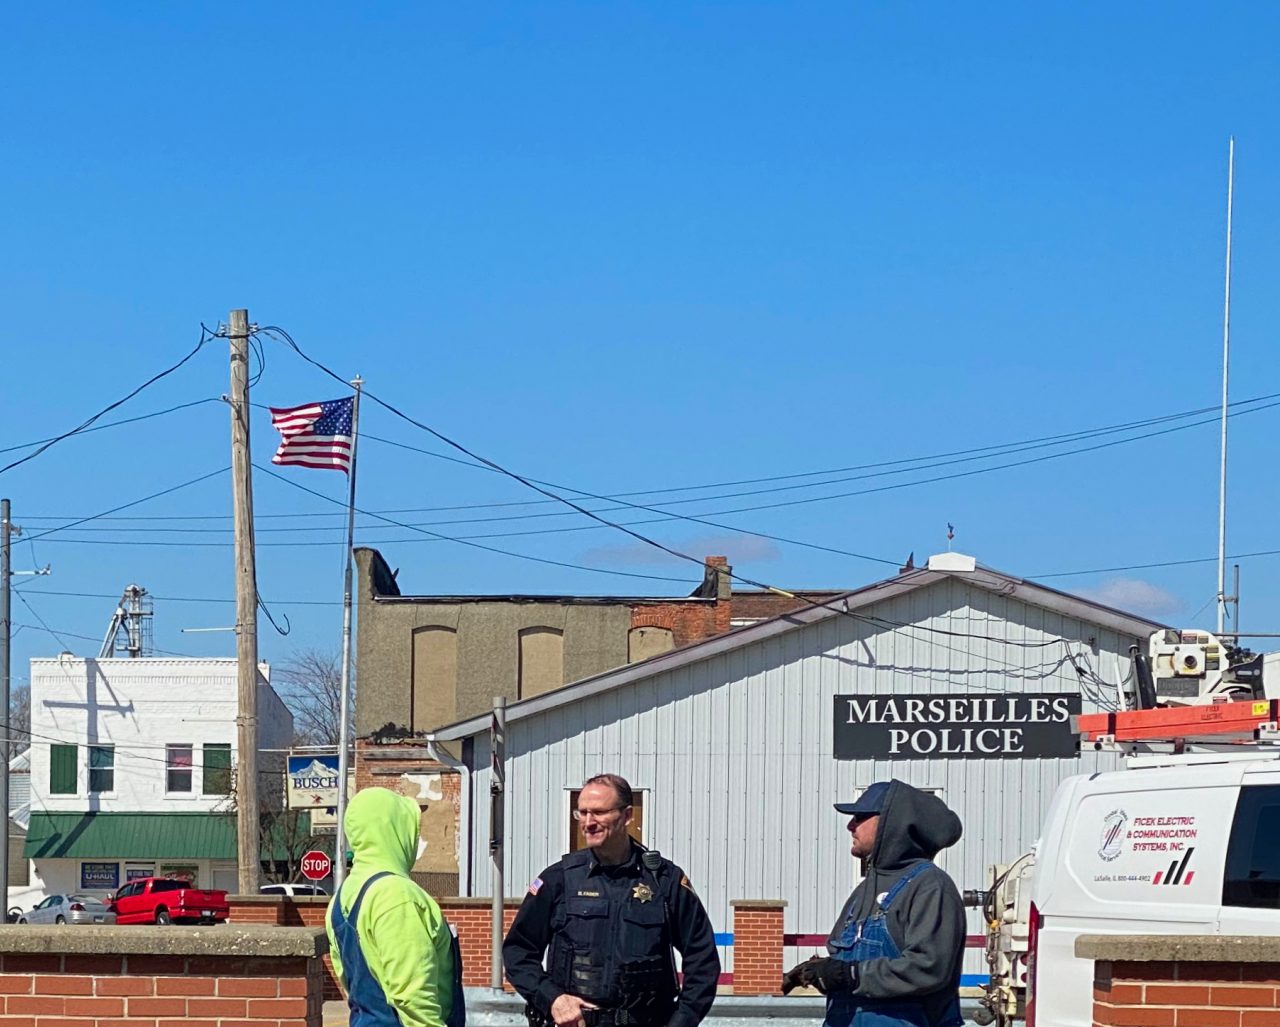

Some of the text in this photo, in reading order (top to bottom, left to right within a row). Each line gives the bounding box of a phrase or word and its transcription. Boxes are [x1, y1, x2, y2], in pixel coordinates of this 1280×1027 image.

[846, 698, 1070, 724] MARSEILLES
[888, 728, 1025, 754] POLICE
[292, 777, 339, 789] BUSCH
[1133, 817, 1195, 826] FICEK ELECTRIC
[1126, 829, 1197, 839] & COMMUNICATION
[1132, 843, 1186, 852] SYSTEMS, INC.
[303, 859, 329, 871] STOP
